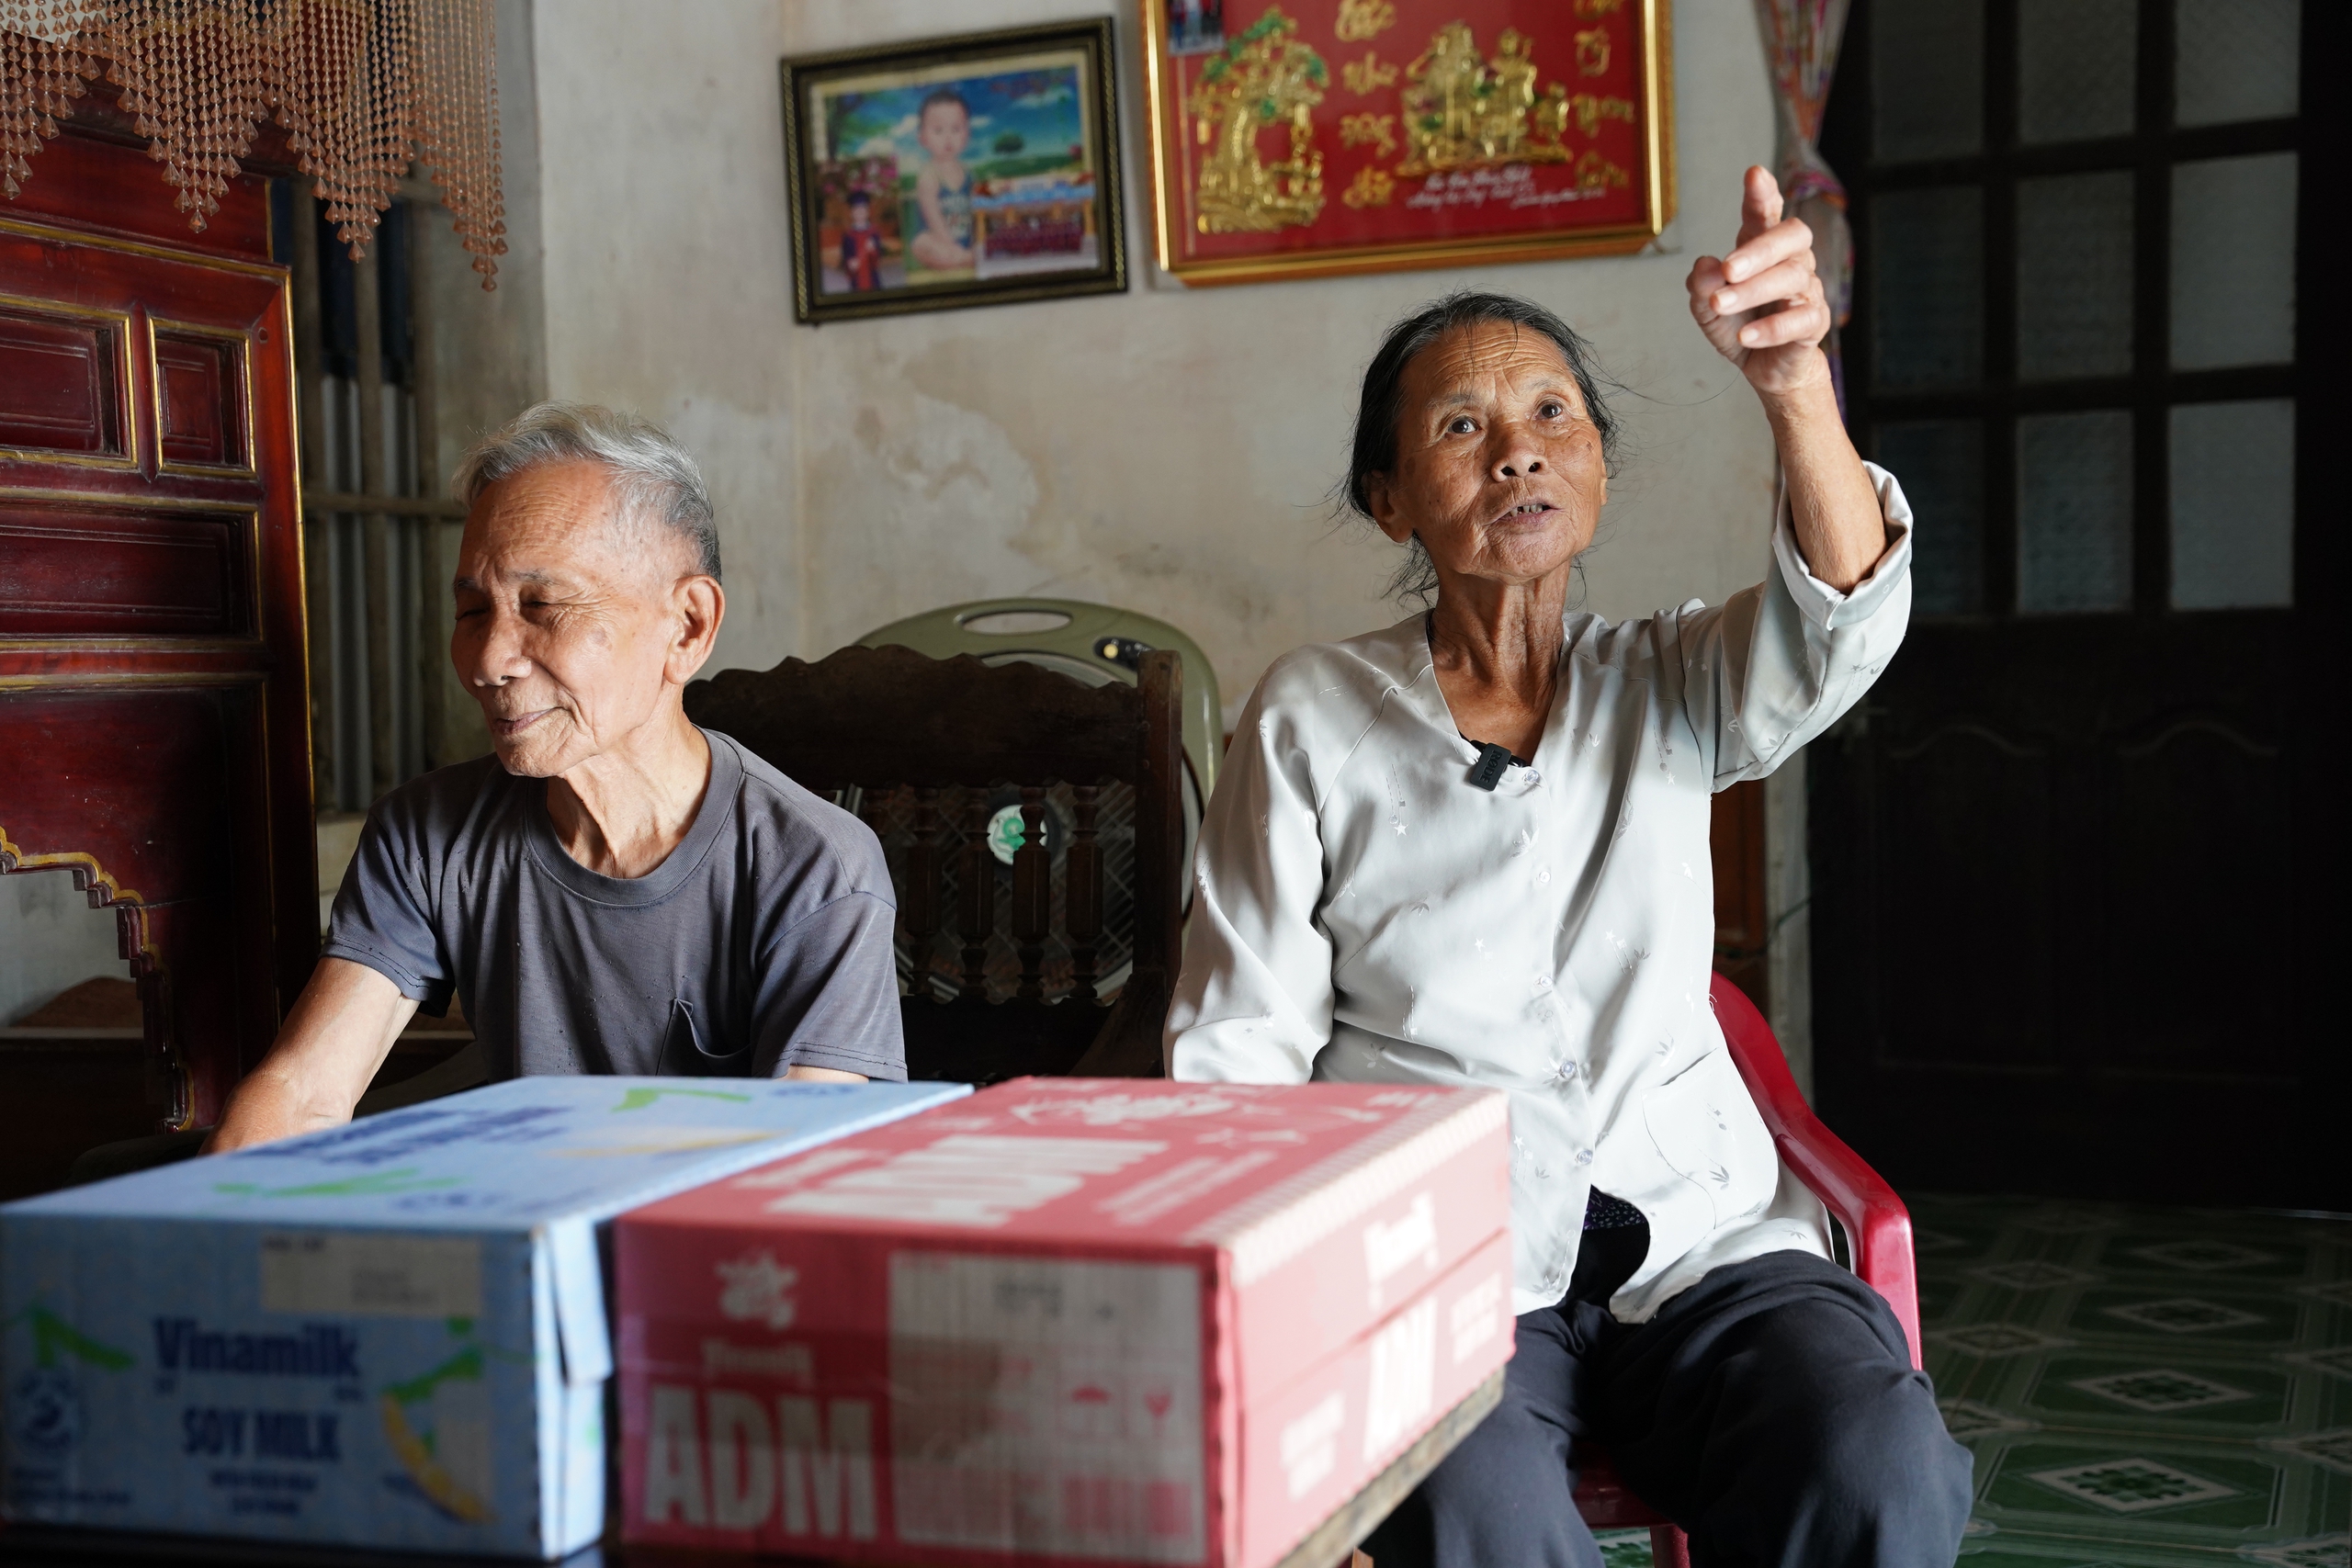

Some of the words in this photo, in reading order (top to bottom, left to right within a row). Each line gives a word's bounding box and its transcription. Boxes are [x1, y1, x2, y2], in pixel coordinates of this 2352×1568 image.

[153, 1316, 360, 1377] Vinamilk
[183, 1406, 245, 1455] SOY
[643, 1382, 877, 1542] ADM
